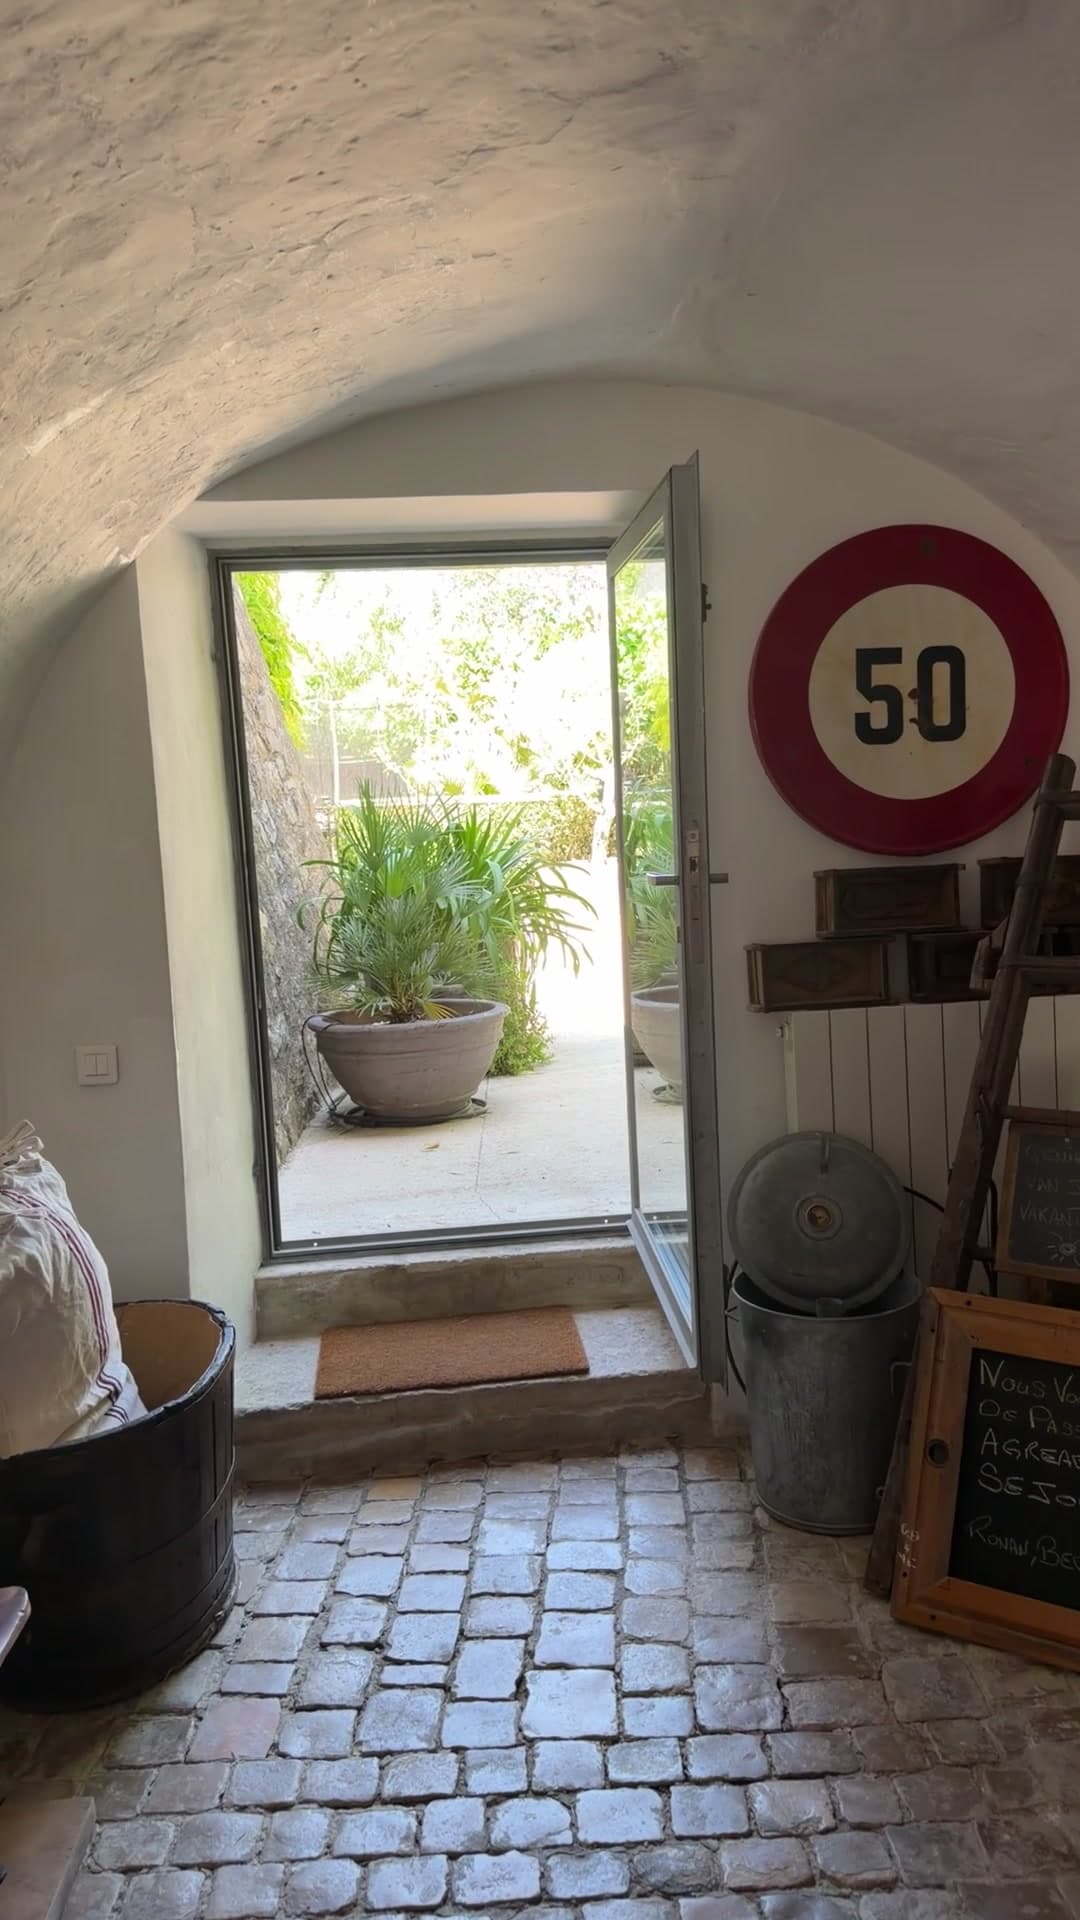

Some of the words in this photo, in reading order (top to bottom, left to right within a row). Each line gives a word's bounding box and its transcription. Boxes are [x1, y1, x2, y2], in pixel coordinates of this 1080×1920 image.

[854, 645, 966, 745] 50
[1053, 1374, 1080, 1403] VO
[977, 1462, 1080, 1507] SEJO
